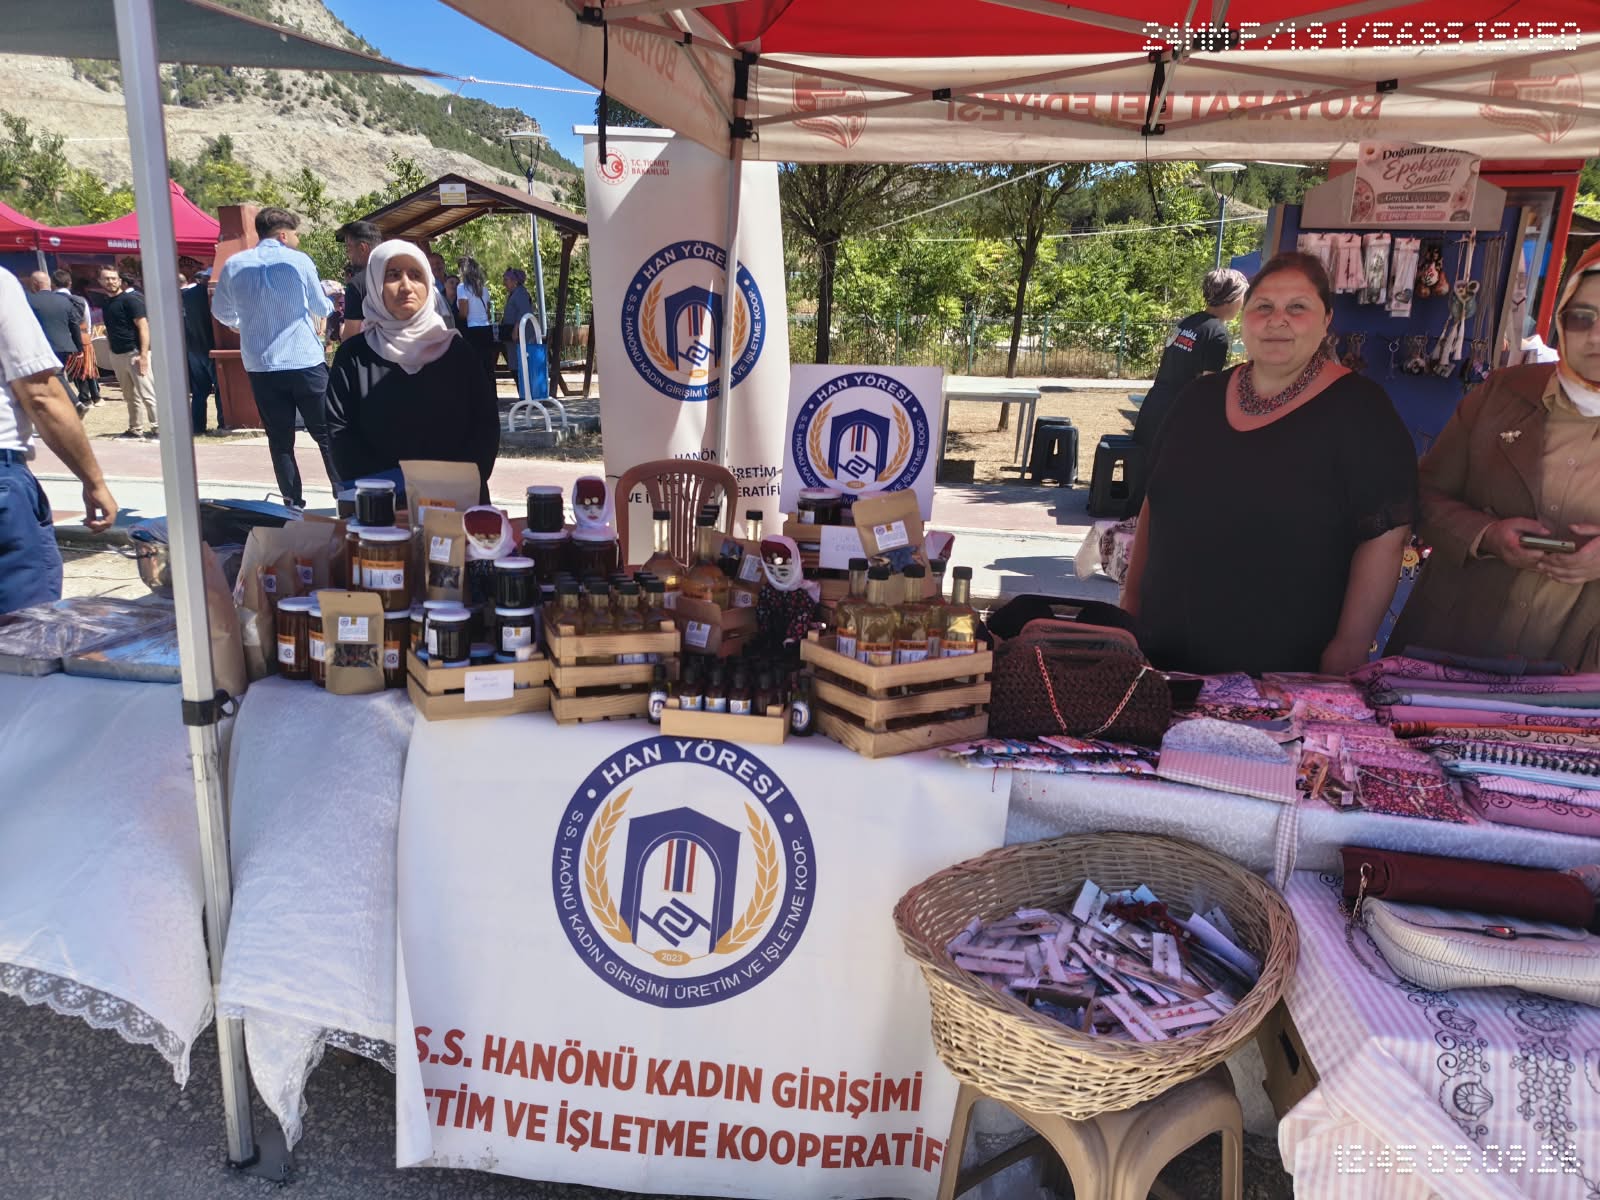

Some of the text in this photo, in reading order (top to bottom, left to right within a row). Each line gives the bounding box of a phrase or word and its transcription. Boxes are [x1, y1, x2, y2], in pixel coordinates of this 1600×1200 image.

[642, 250, 676, 280] HAN
[640, 361, 665, 388] KADIN
[734, 363, 748, 376] VE
[744, 321, 762, 363] İŞLETME
[816, 374, 913, 404] HAN YÖRESİ
[601, 740, 785, 804] HAN YÖRESİ
[559, 810, 809, 999] S.S. HAÖNÜ KADIN GİRİŞİMİ ÜRETİM VE İŞLETME KOOP.
[661, 953, 684, 963] 2023
[482, 1034, 638, 1091] HANÖNÜ
[645, 1057, 763, 1104] KADIN
[772, 1067, 923, 1120] GİRİŞİMİ
[504, 1099, 549, 1142] VE
[556, 1100, 709, 1158] İŞLETME
